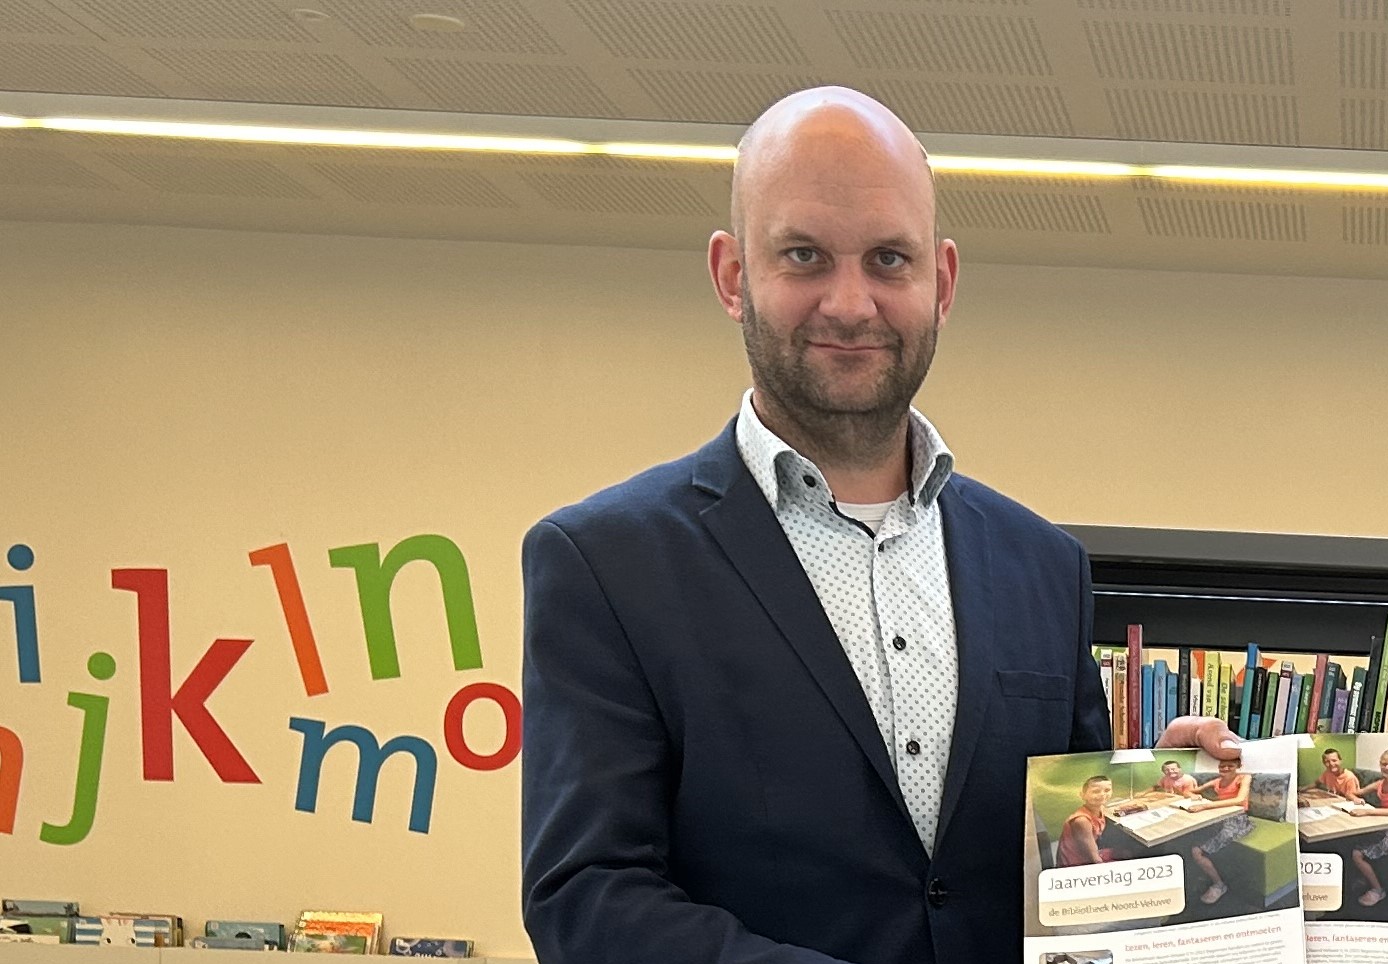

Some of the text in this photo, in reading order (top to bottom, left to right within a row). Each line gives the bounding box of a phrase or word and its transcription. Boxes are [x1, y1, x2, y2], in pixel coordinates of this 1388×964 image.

[111, 569, 262, 784] k
[40, 652, 116, 845] j
[289, 716, 437, 834] m
[1048, 864, 1173, 891] Jaarverslag 2023
[1048, 906, 1060, 917] de
[1062, 903, 1110, 916] Bibliotheek
[1224, 932, 1235, 941] en
